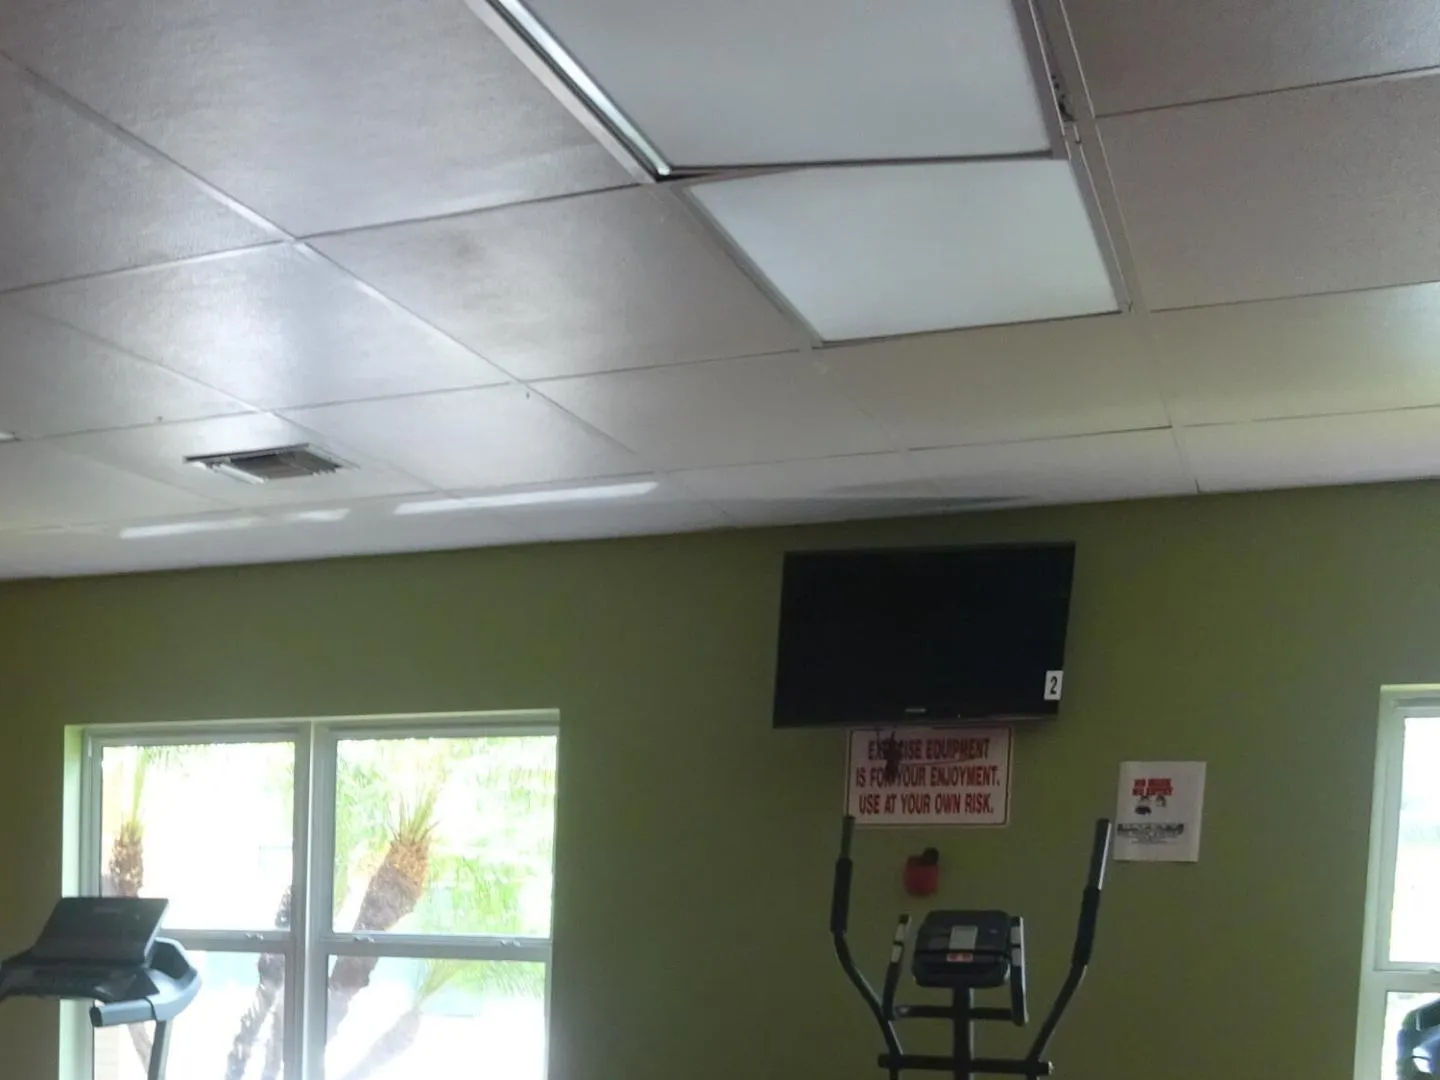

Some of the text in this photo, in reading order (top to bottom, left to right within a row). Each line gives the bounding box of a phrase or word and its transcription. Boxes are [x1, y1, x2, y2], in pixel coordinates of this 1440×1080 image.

[1050, 675, 1058, 695] 2
[868, 738, 990, 760] EXISE EQUIPMENT
[856, 768, 866, 788] IS
[896, 766, 926, 787] YOUR
[929, 765, 1000, 787] ENJOYMENT.
[859, 793, 993, 815] USE AT YOUR OWN RISK.
